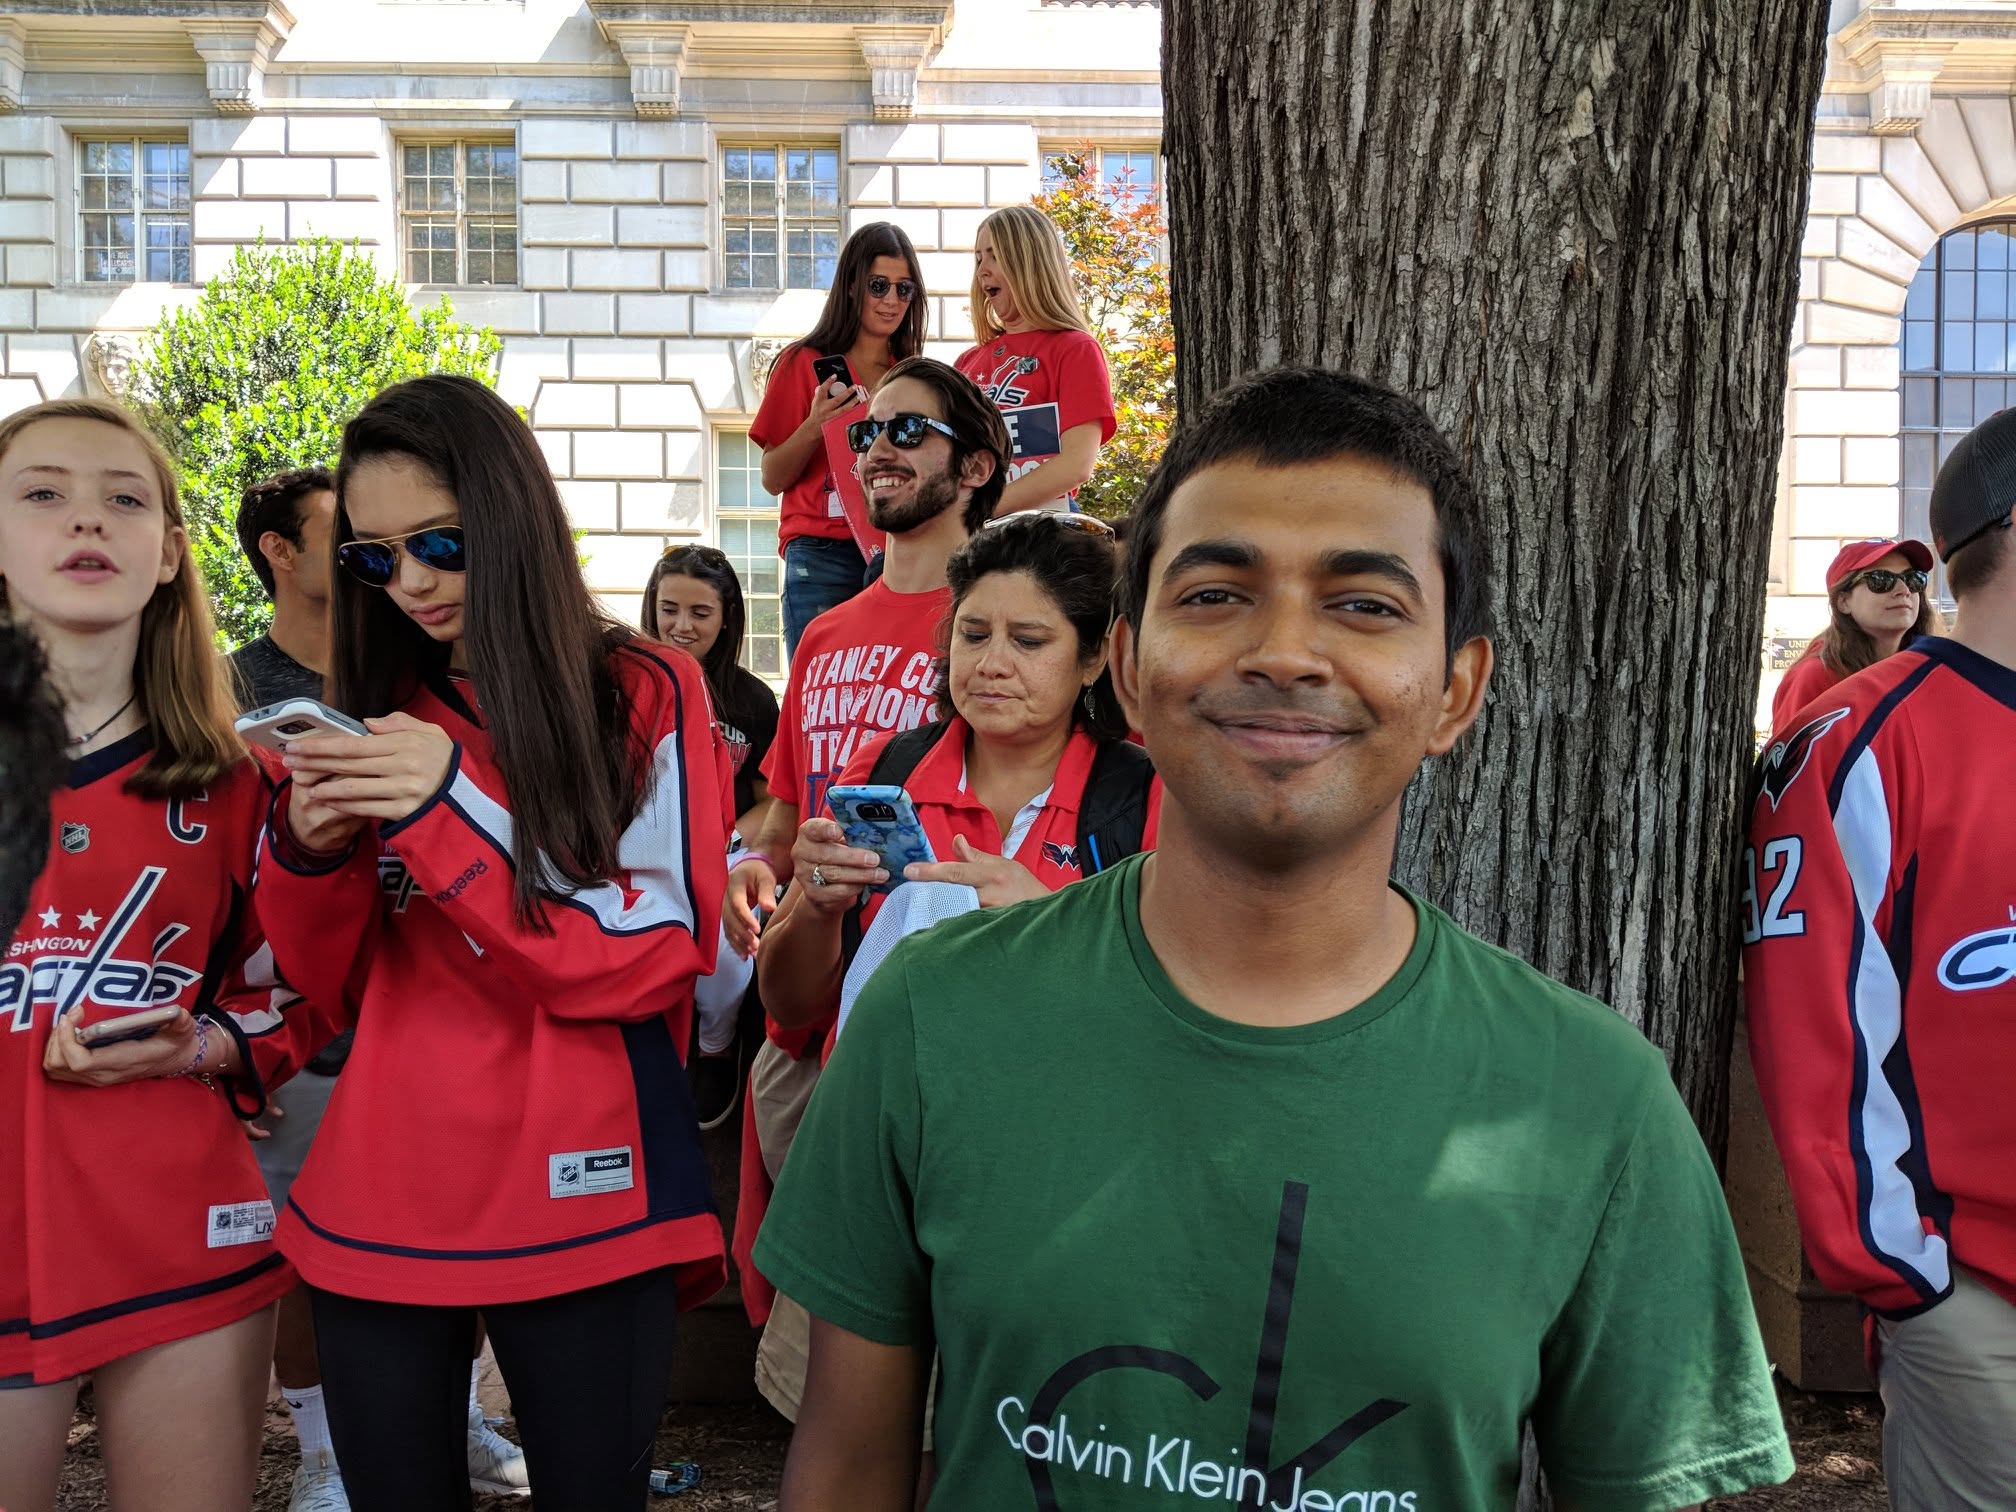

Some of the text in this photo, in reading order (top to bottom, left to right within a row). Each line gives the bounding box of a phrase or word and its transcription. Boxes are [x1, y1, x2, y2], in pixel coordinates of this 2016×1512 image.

[802, 645, 945, 696] STANLEY CU
[801, 682, 942, 733] CHAMPION
[593, 1157, 623, 1168] Reebok
[256, 1221, 275, 1234] L/X
[996, 1396, 1418, 1512] Calvin Klein Jeans
